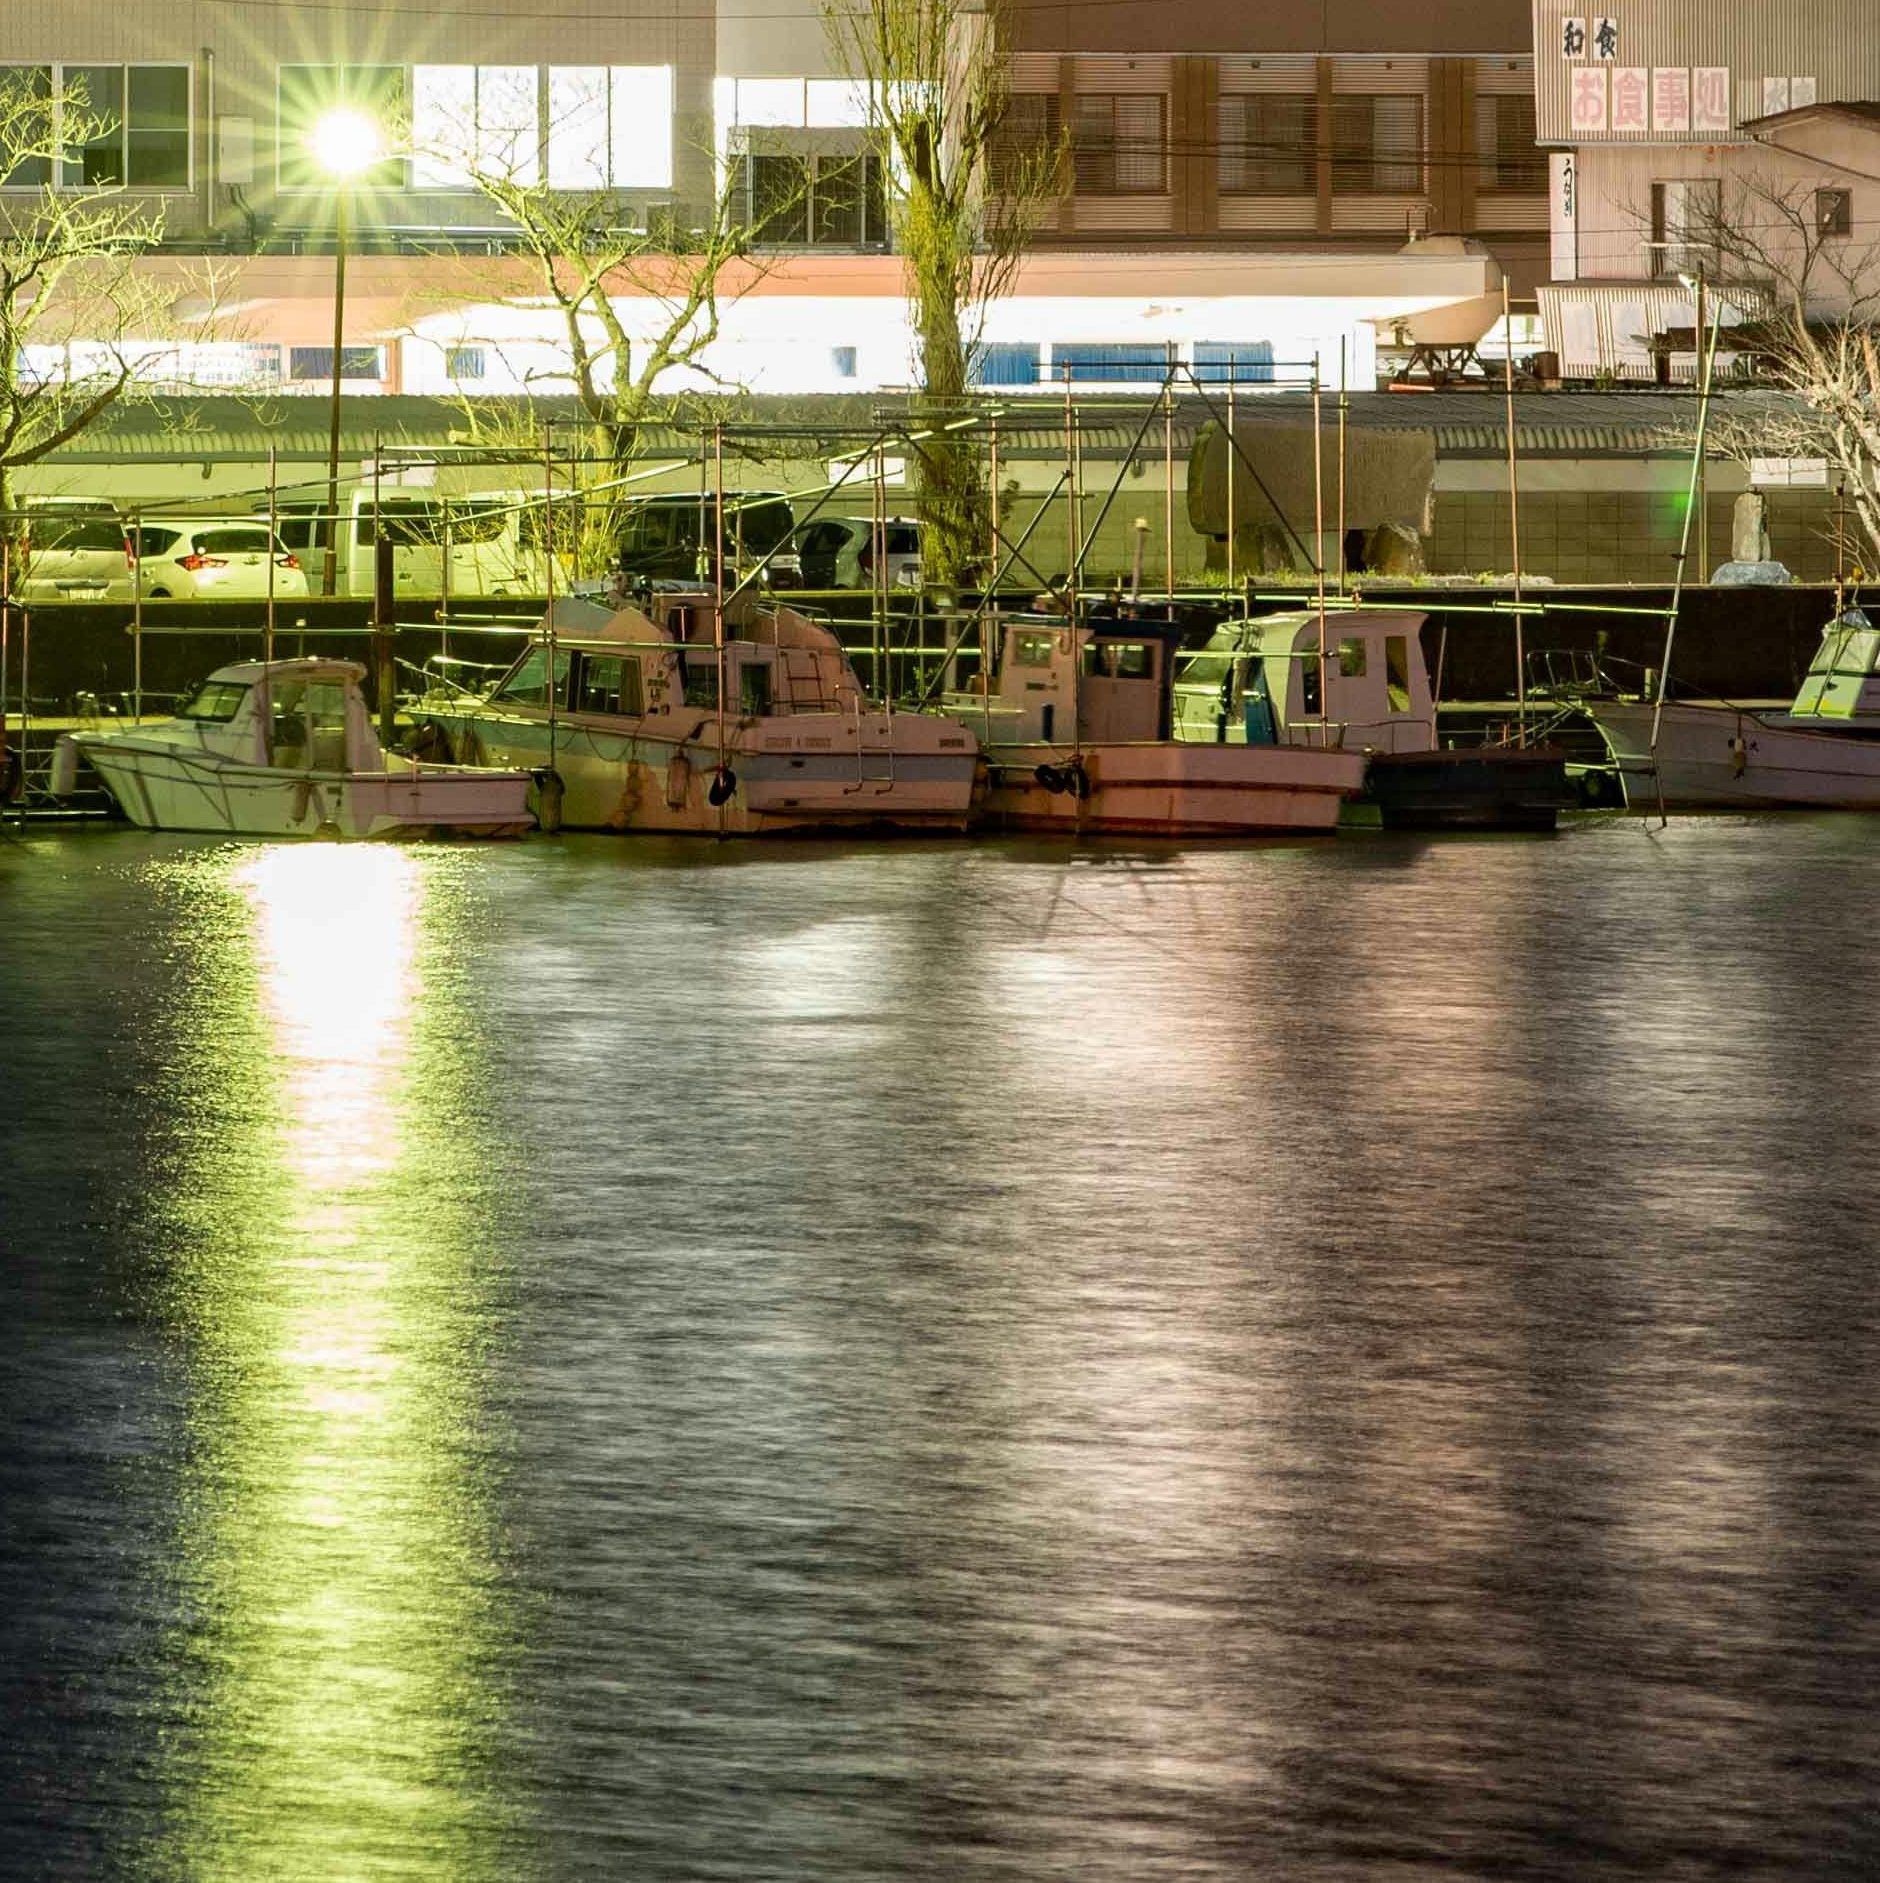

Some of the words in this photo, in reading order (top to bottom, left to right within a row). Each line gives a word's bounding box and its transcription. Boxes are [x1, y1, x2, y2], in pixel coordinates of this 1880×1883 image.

[1563, 19, 1618, 59] 和食
[1574, 71, 1729, 127] お食事処
